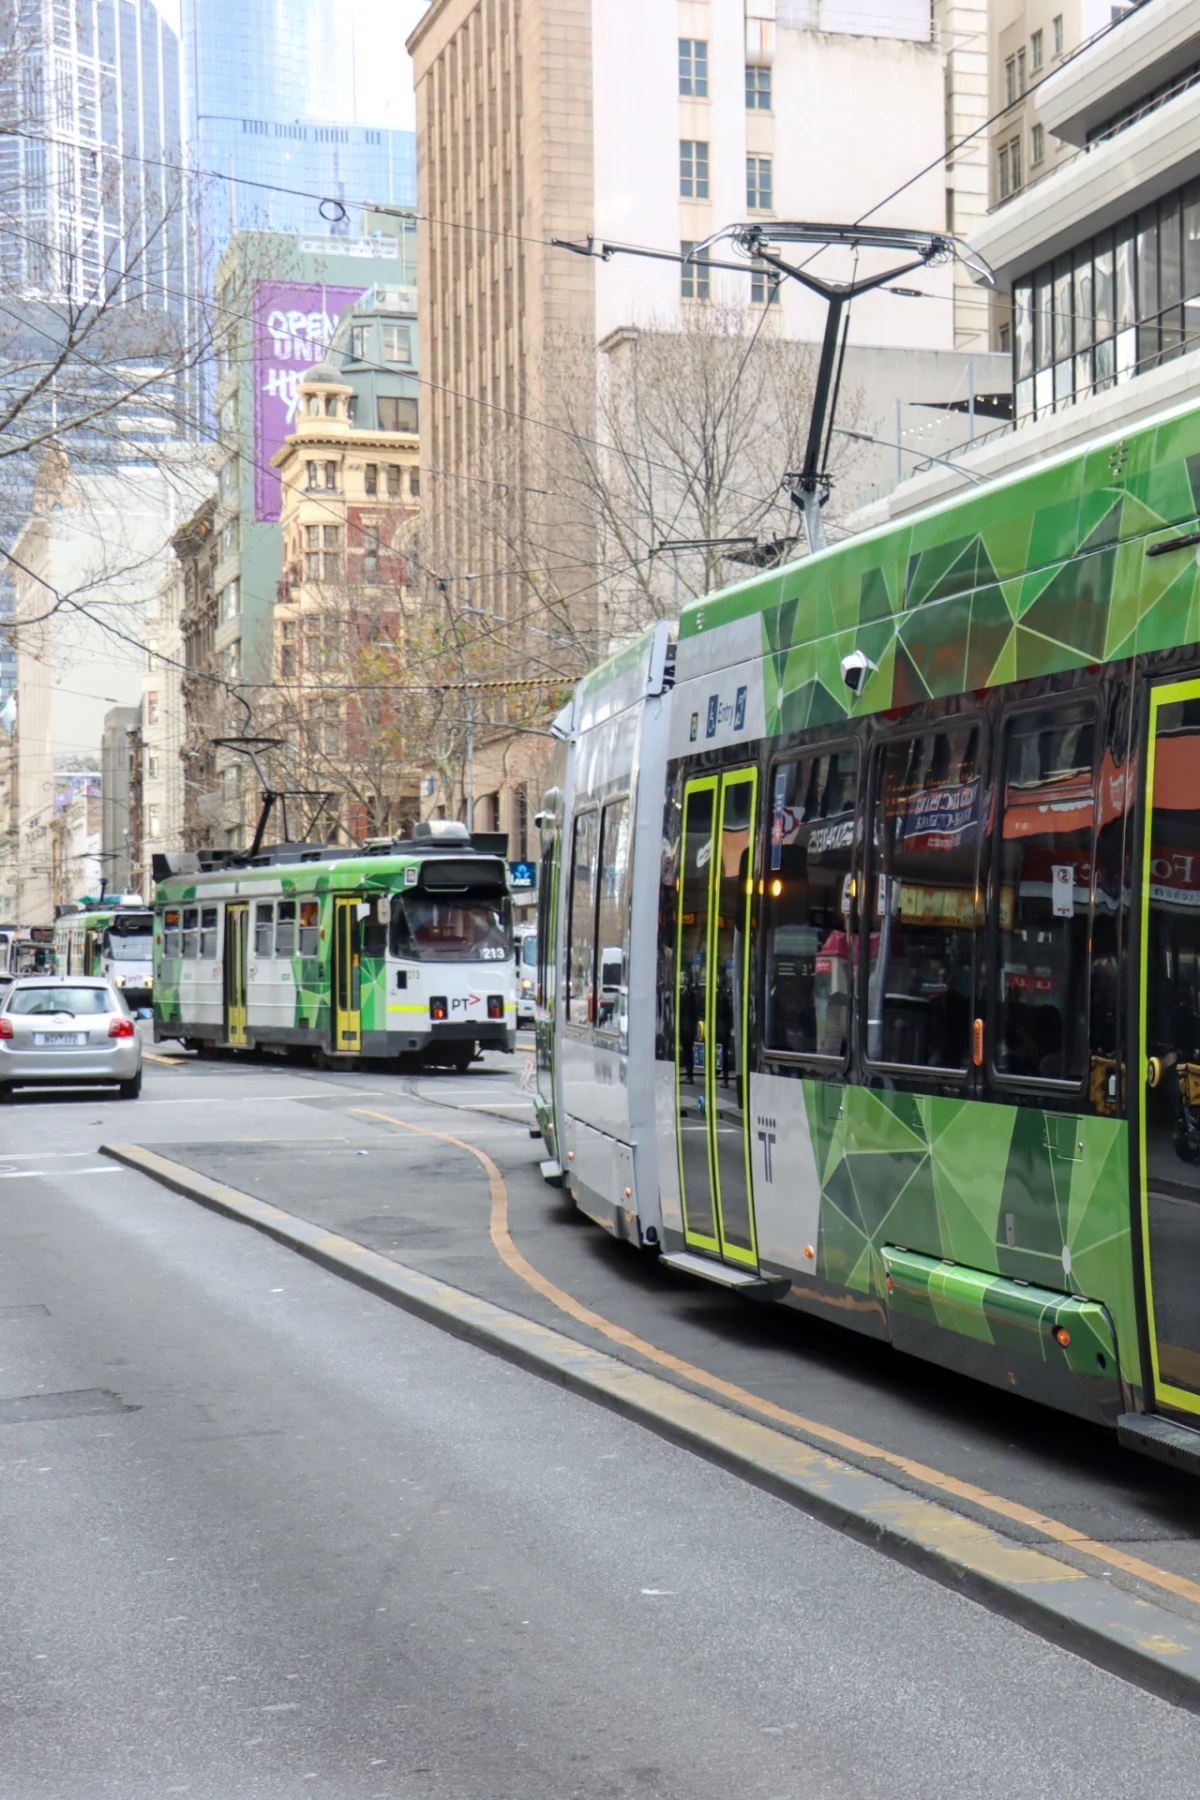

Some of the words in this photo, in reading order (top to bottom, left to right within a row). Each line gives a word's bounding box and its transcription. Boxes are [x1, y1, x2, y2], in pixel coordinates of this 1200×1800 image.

[266, 310, 340, 340] OPEN
[483, 948, 505, 959] 213
[407, 970, 420, 980] 213
